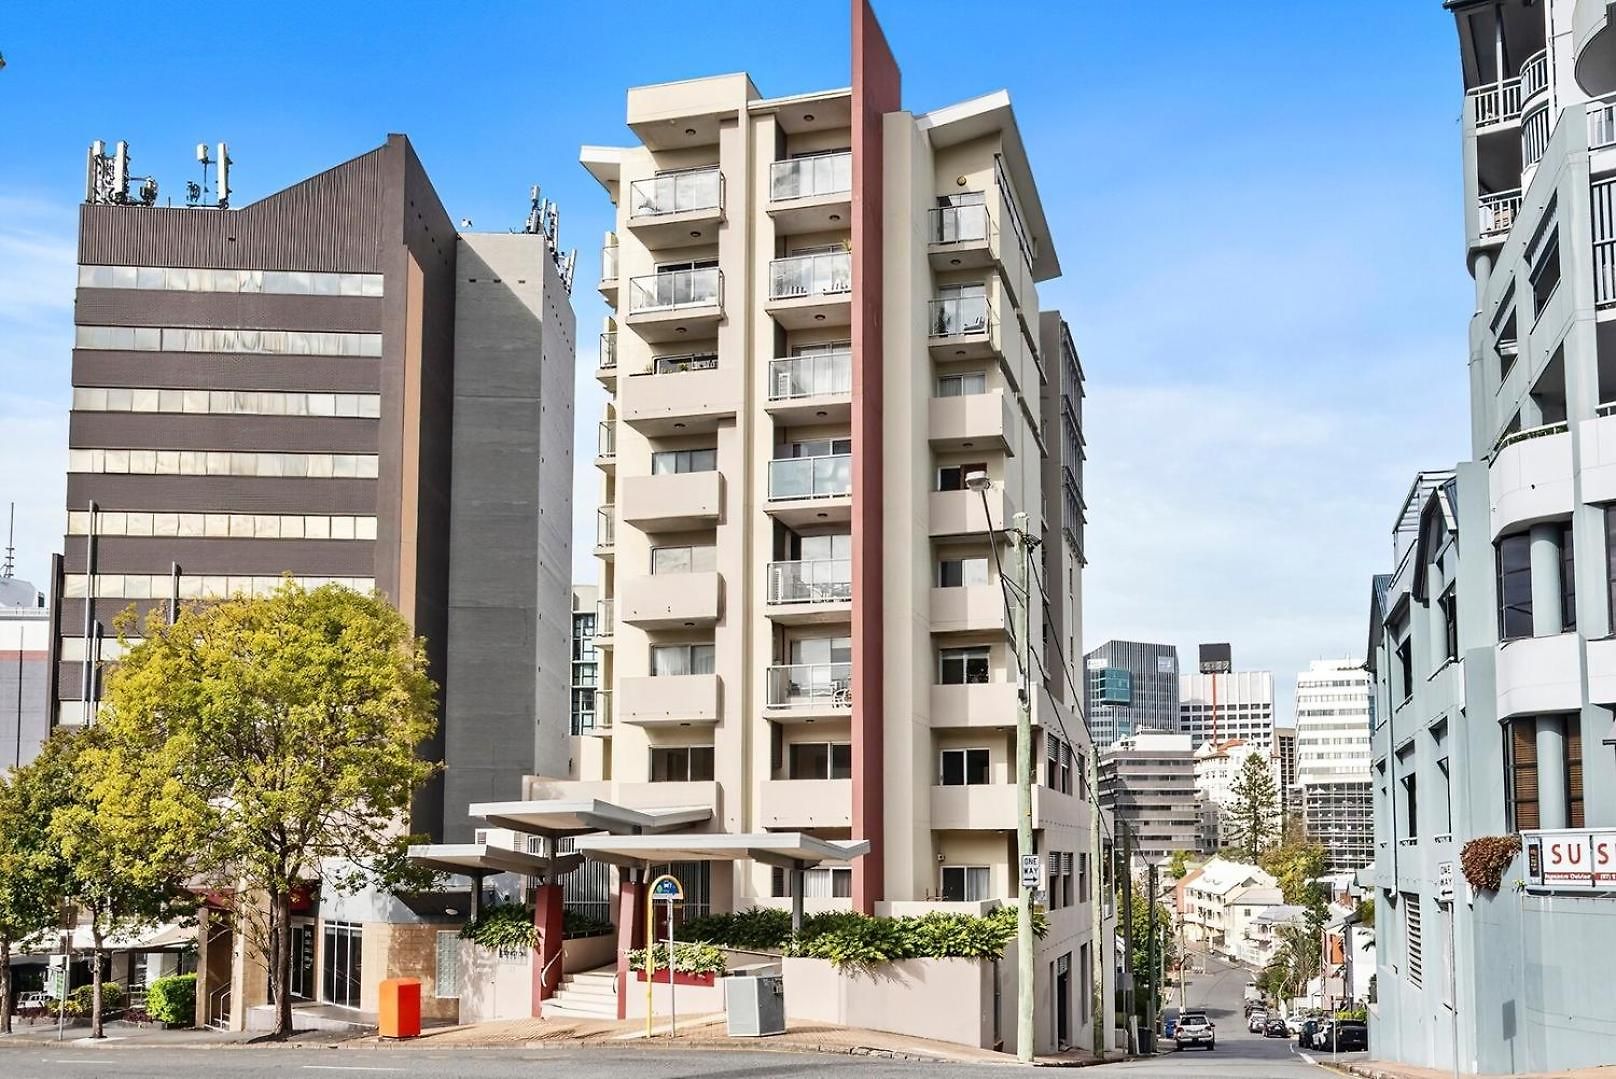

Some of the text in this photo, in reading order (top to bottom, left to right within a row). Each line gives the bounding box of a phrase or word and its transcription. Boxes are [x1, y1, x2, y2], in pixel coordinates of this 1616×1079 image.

[1551, 843, 1616, 865] SUS
[1024, 857, 1038, 865] ONE
[1440, 864, 1452, 875] ONE
[1440, 878, 1452, 886] WAY
